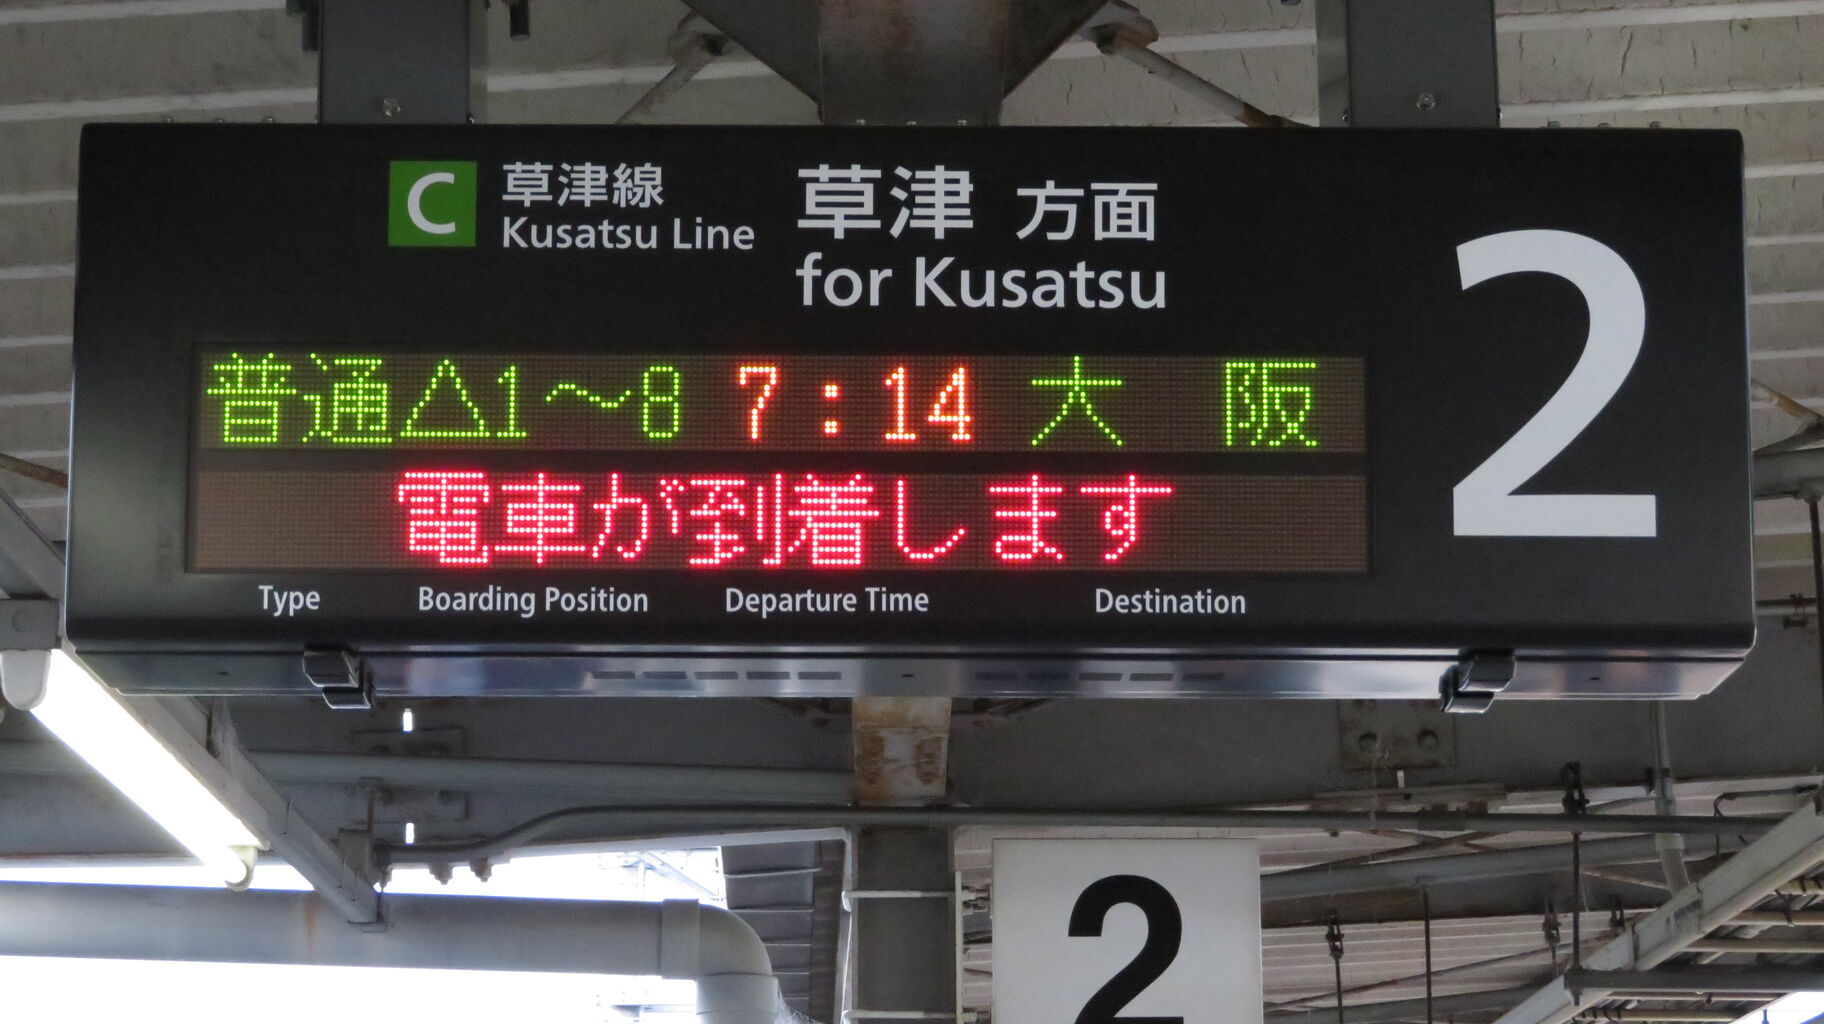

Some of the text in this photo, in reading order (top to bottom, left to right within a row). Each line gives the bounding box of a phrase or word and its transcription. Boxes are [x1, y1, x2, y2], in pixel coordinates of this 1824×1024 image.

[407, 172, 456, 235] C
[503, 162, 664, 208] 草津線
[798, 165, 1159, 242] 草津 方面
[503, 217, 756, 251] Kusatsu Line
[796, 251, 1166, 310] for Kusatsu
[206, 352, 393, 444] 普通
[1453, 229, 1657, 538] 2
[395, 470, 1174, 567] 電車が到着します
[258, 585, 321, 618] Type
[418, 585, 649, 618] Boarding Position
[725, 587, 930, 619] Departure Time
[1095, 588, 1246, 614] Destination
[1068, 874, 1184, 1024] 2
